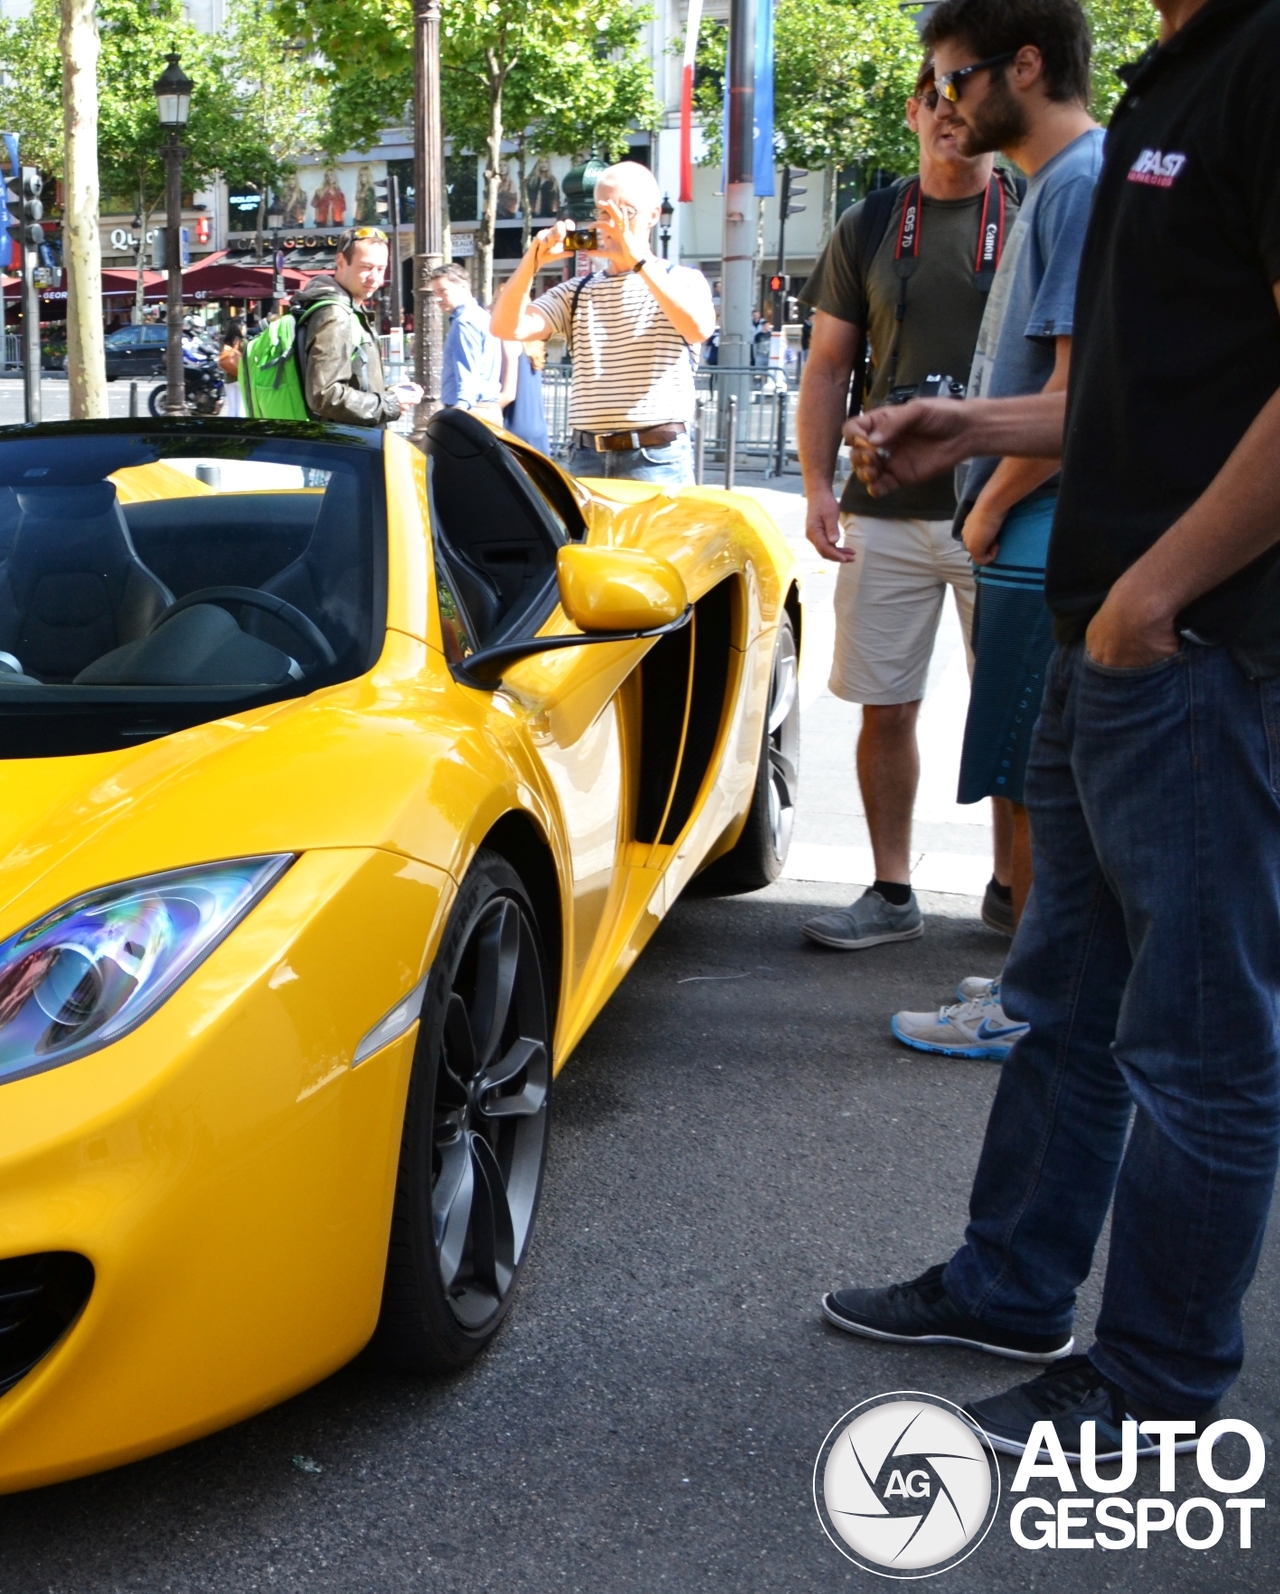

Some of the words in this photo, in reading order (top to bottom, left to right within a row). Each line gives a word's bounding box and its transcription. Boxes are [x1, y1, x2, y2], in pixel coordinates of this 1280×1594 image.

[904, 206, 916, 232] EOS
[110, 229, 154, 251] Quc
[283, 233, 338, 249] GEORG
[901, 234, 913, 248] 7D
[983, 223, 998, 261] Canon
[43, 291, 67, 299] GEOR
